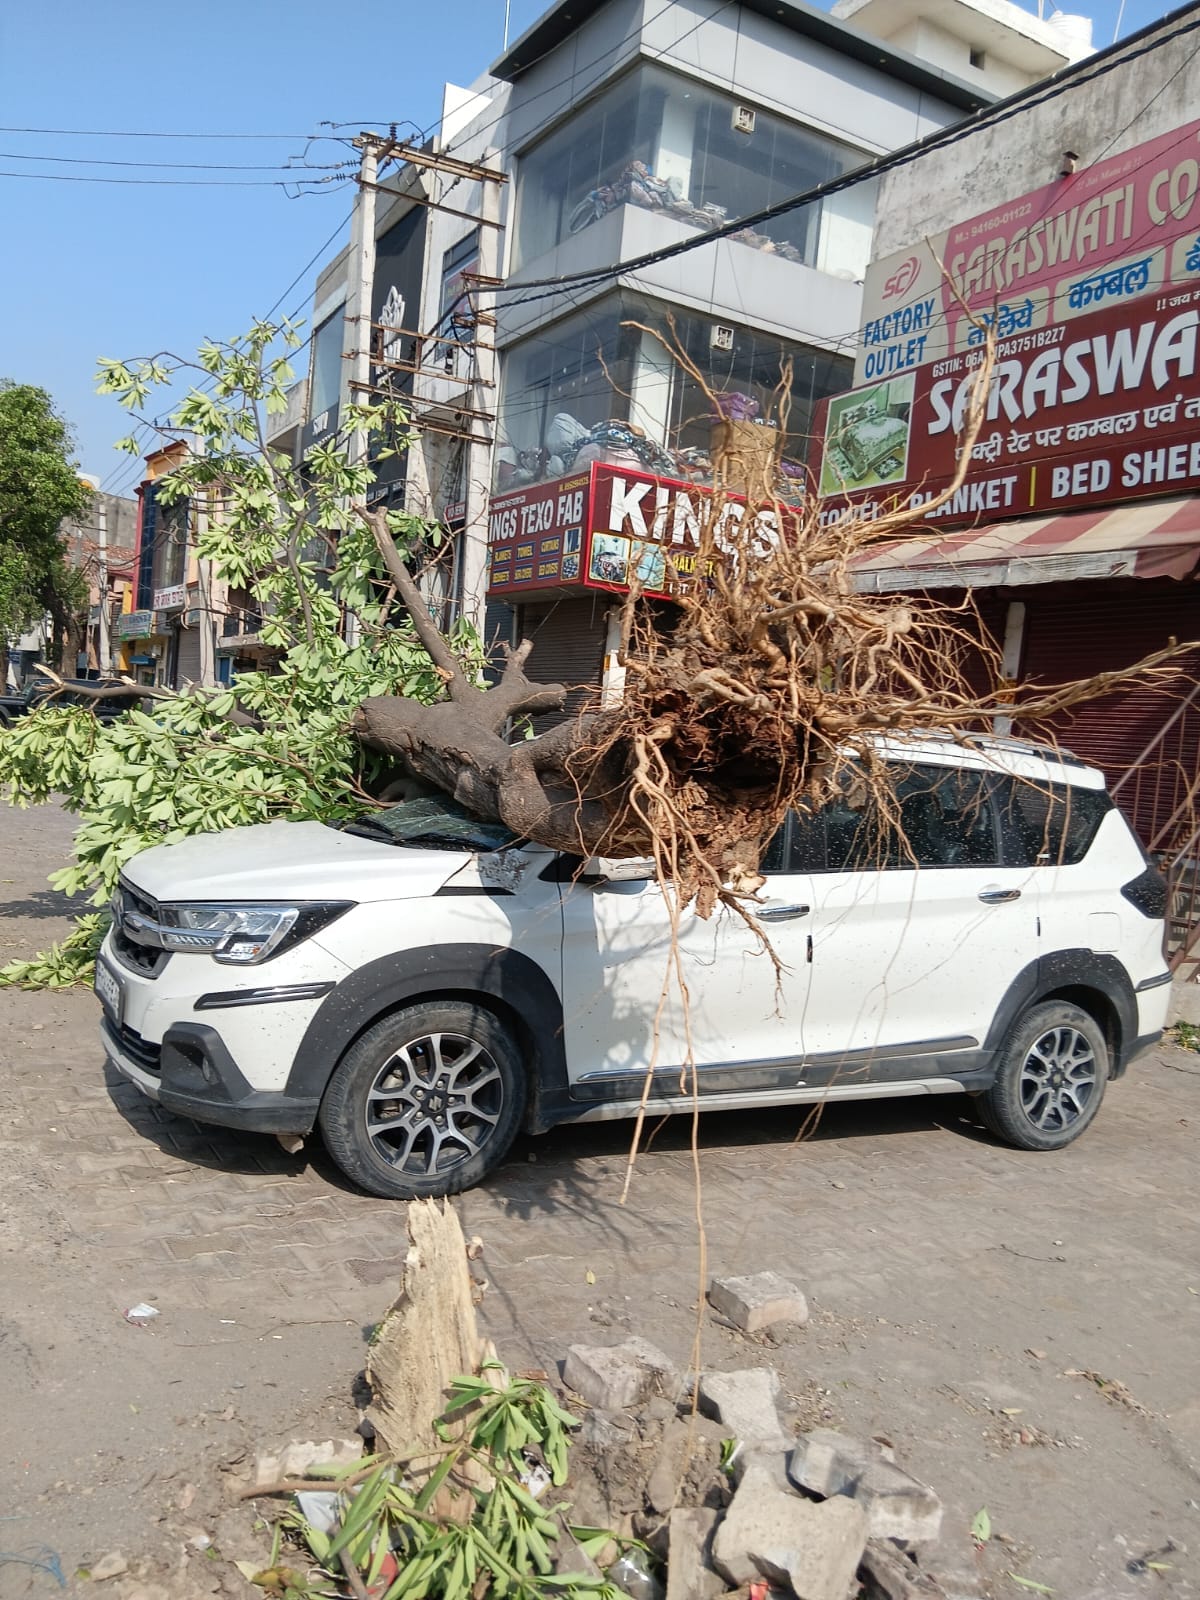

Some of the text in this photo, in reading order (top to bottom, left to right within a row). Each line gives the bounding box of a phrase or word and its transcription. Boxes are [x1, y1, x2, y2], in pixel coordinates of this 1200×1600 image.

[950, 183, 1135, 302] SARASWATI
[1068, 257, 1153, 309] कम्बल
[864, 298, 935, 347] FACTORY
[864, 335, 927, 379] OUTLET
[932, 326, 1066, 377] GSTIN: 06APA3751B2Z7
[1007, 429, 1033, 454] रेट
[1035, 426, 1063, 447] पर
[1067, 410, 1140, 441] कम्बल
[1143, 393, 1183, 428] एवं
[1051, 459, 1111, 498] BED
[488, 508, 518, 543] INGS
[520, 498, 554, 536] TEXO
[556, 490, 584, 527] FAB
[609, 476, 781, 560] KINGS
